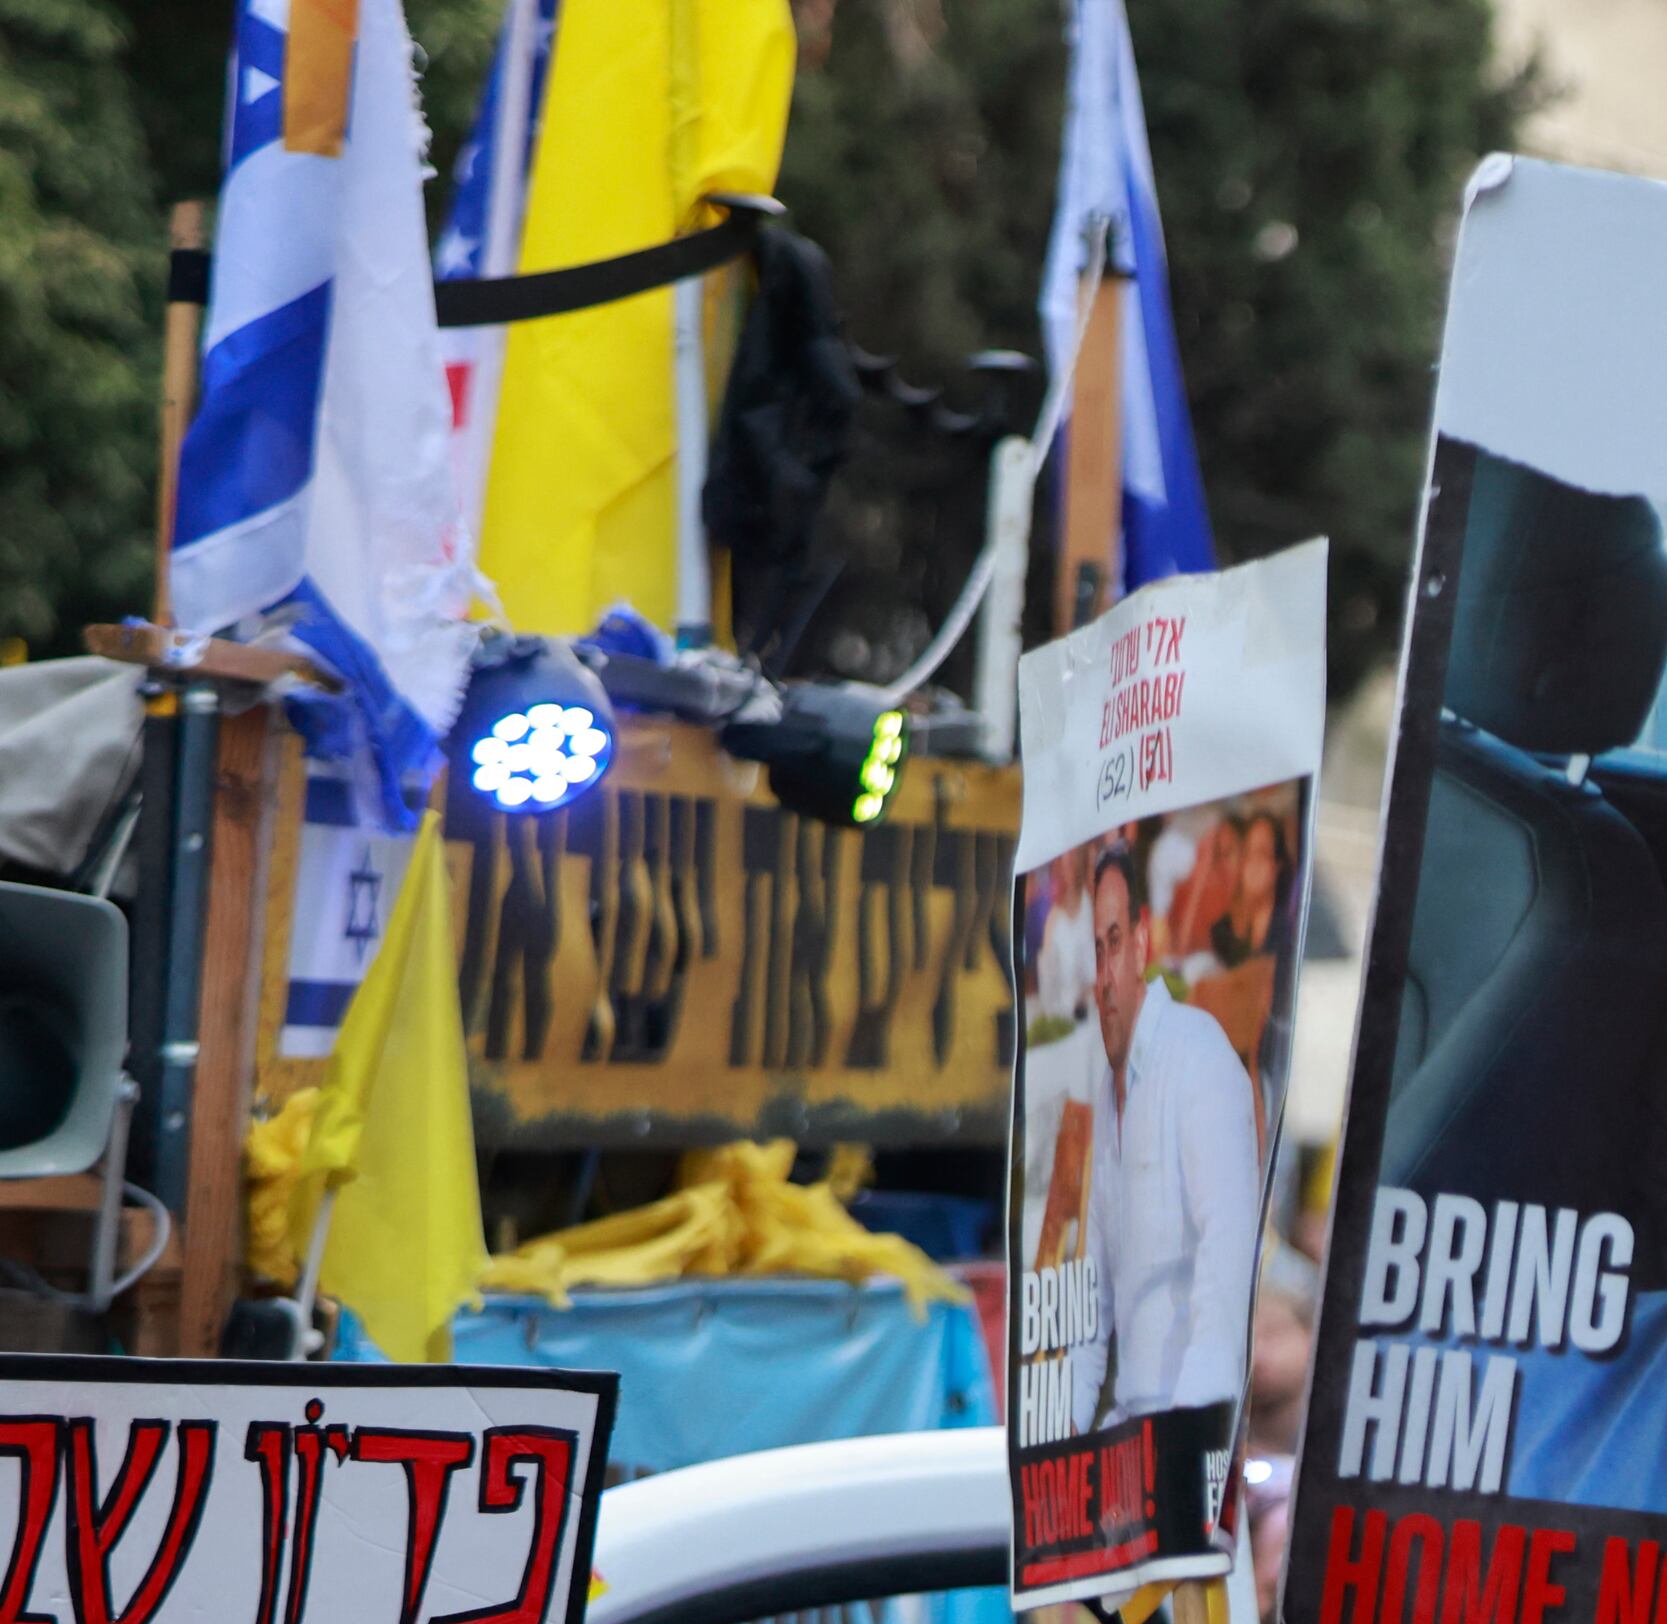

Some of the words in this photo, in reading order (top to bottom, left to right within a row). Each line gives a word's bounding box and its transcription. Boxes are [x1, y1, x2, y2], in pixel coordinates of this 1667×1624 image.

[1146, 615, 1185, 667] אלי
[1115, 670, 1185, 741] SHARABI
[1021, 1255, 1098, 1356] BRING
[1359, 1186, 1635, 1352] BRING
[1019, 1355, 1073, 1449] HIM
[1338, 1339, 1517, 1495] HIM
[1020, 1450, 1095, 1549] HOME
